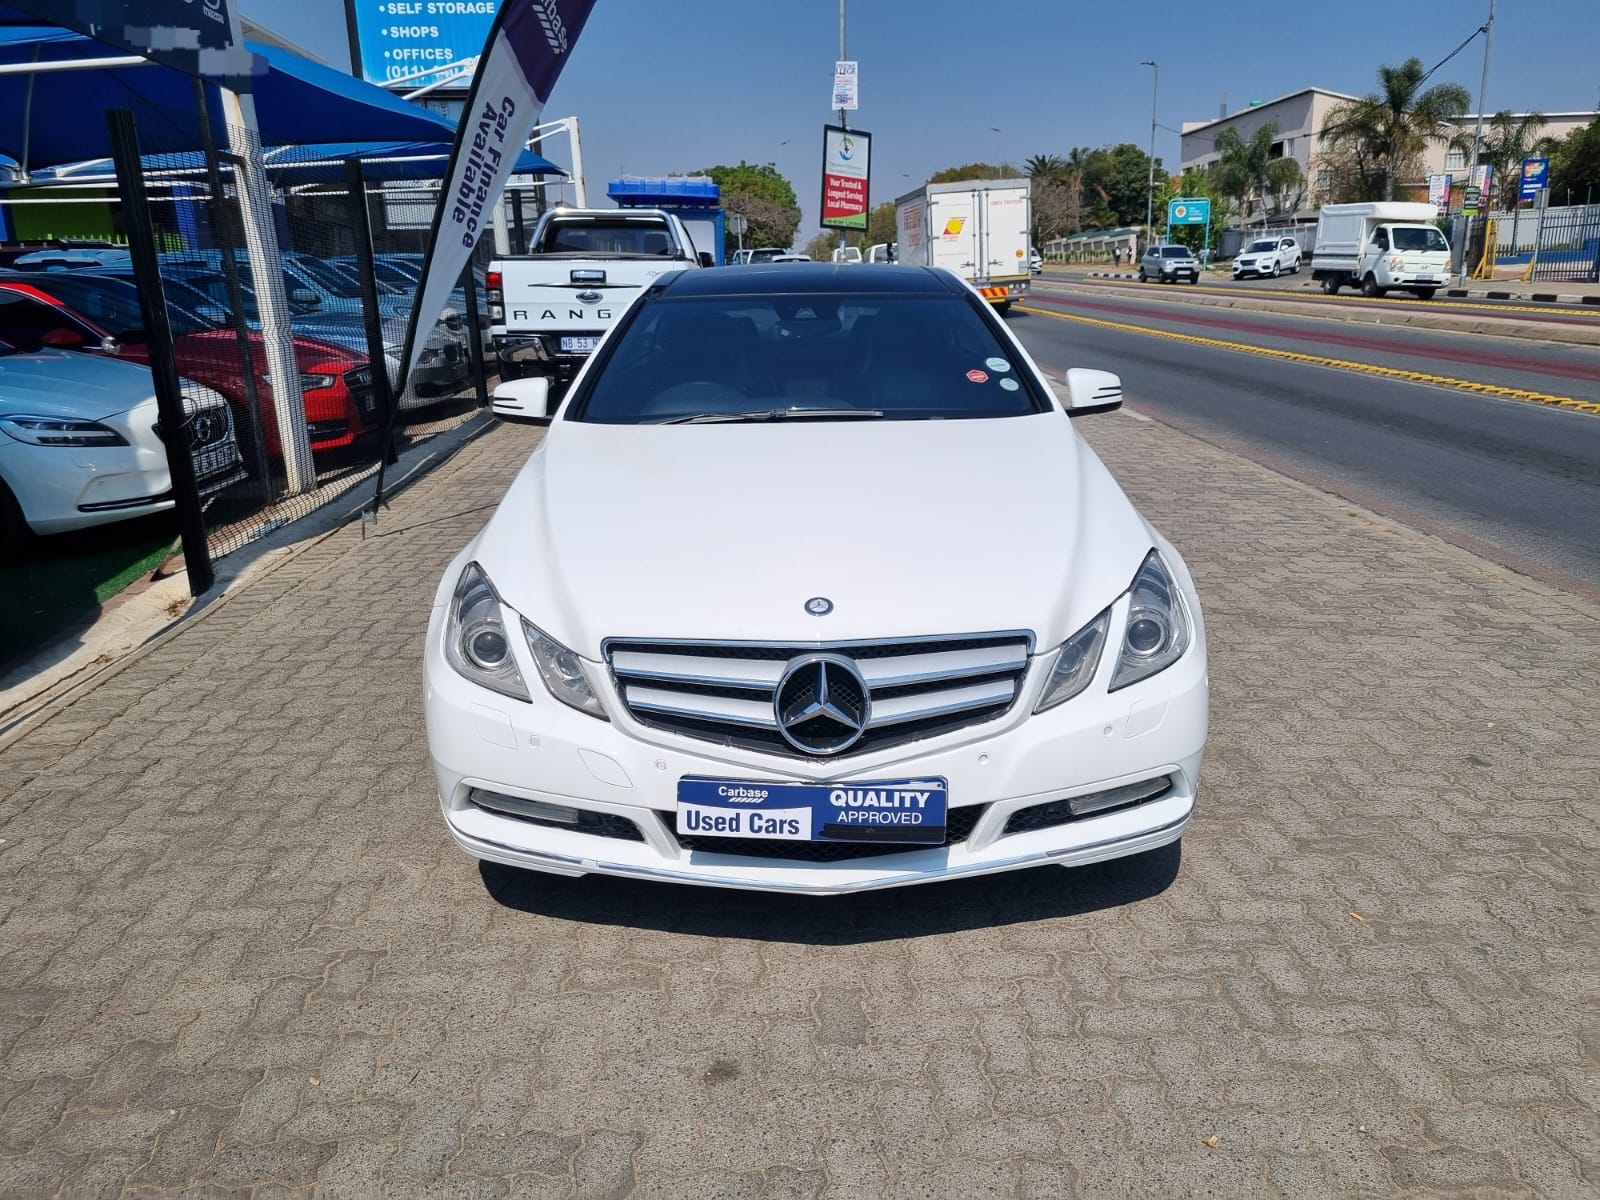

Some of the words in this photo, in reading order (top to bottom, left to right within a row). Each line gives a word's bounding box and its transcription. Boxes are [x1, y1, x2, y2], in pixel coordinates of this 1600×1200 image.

[388, 3, 422, 14] SELF
[428, 2, 495, 14] STORAGE
[390, 26, 439, 38] SHOPS
[392, 48, 453, 60] OFFICES
[494, 96, 515, 143] Car
[452, 101, 498, 224] Available
[841, 179, 857, 189] Trusted
[462, 146, 502, 249] Finance
[828, 188, 845, 199] Longest
[847, 190, 863, 202] Serving
[828, 199, 840, 208] Local
[841, 200, 862, 213] Pharmacy
[577, 338, 588, 348] 53
[718, 786, 768, 798] Carbase
[830, 790, 930, 808] QUALITY
[686, 809, 741, 833] Used
[749, 812, 800, 835] Cars
[838, 810, 922, 825] APPROVED
